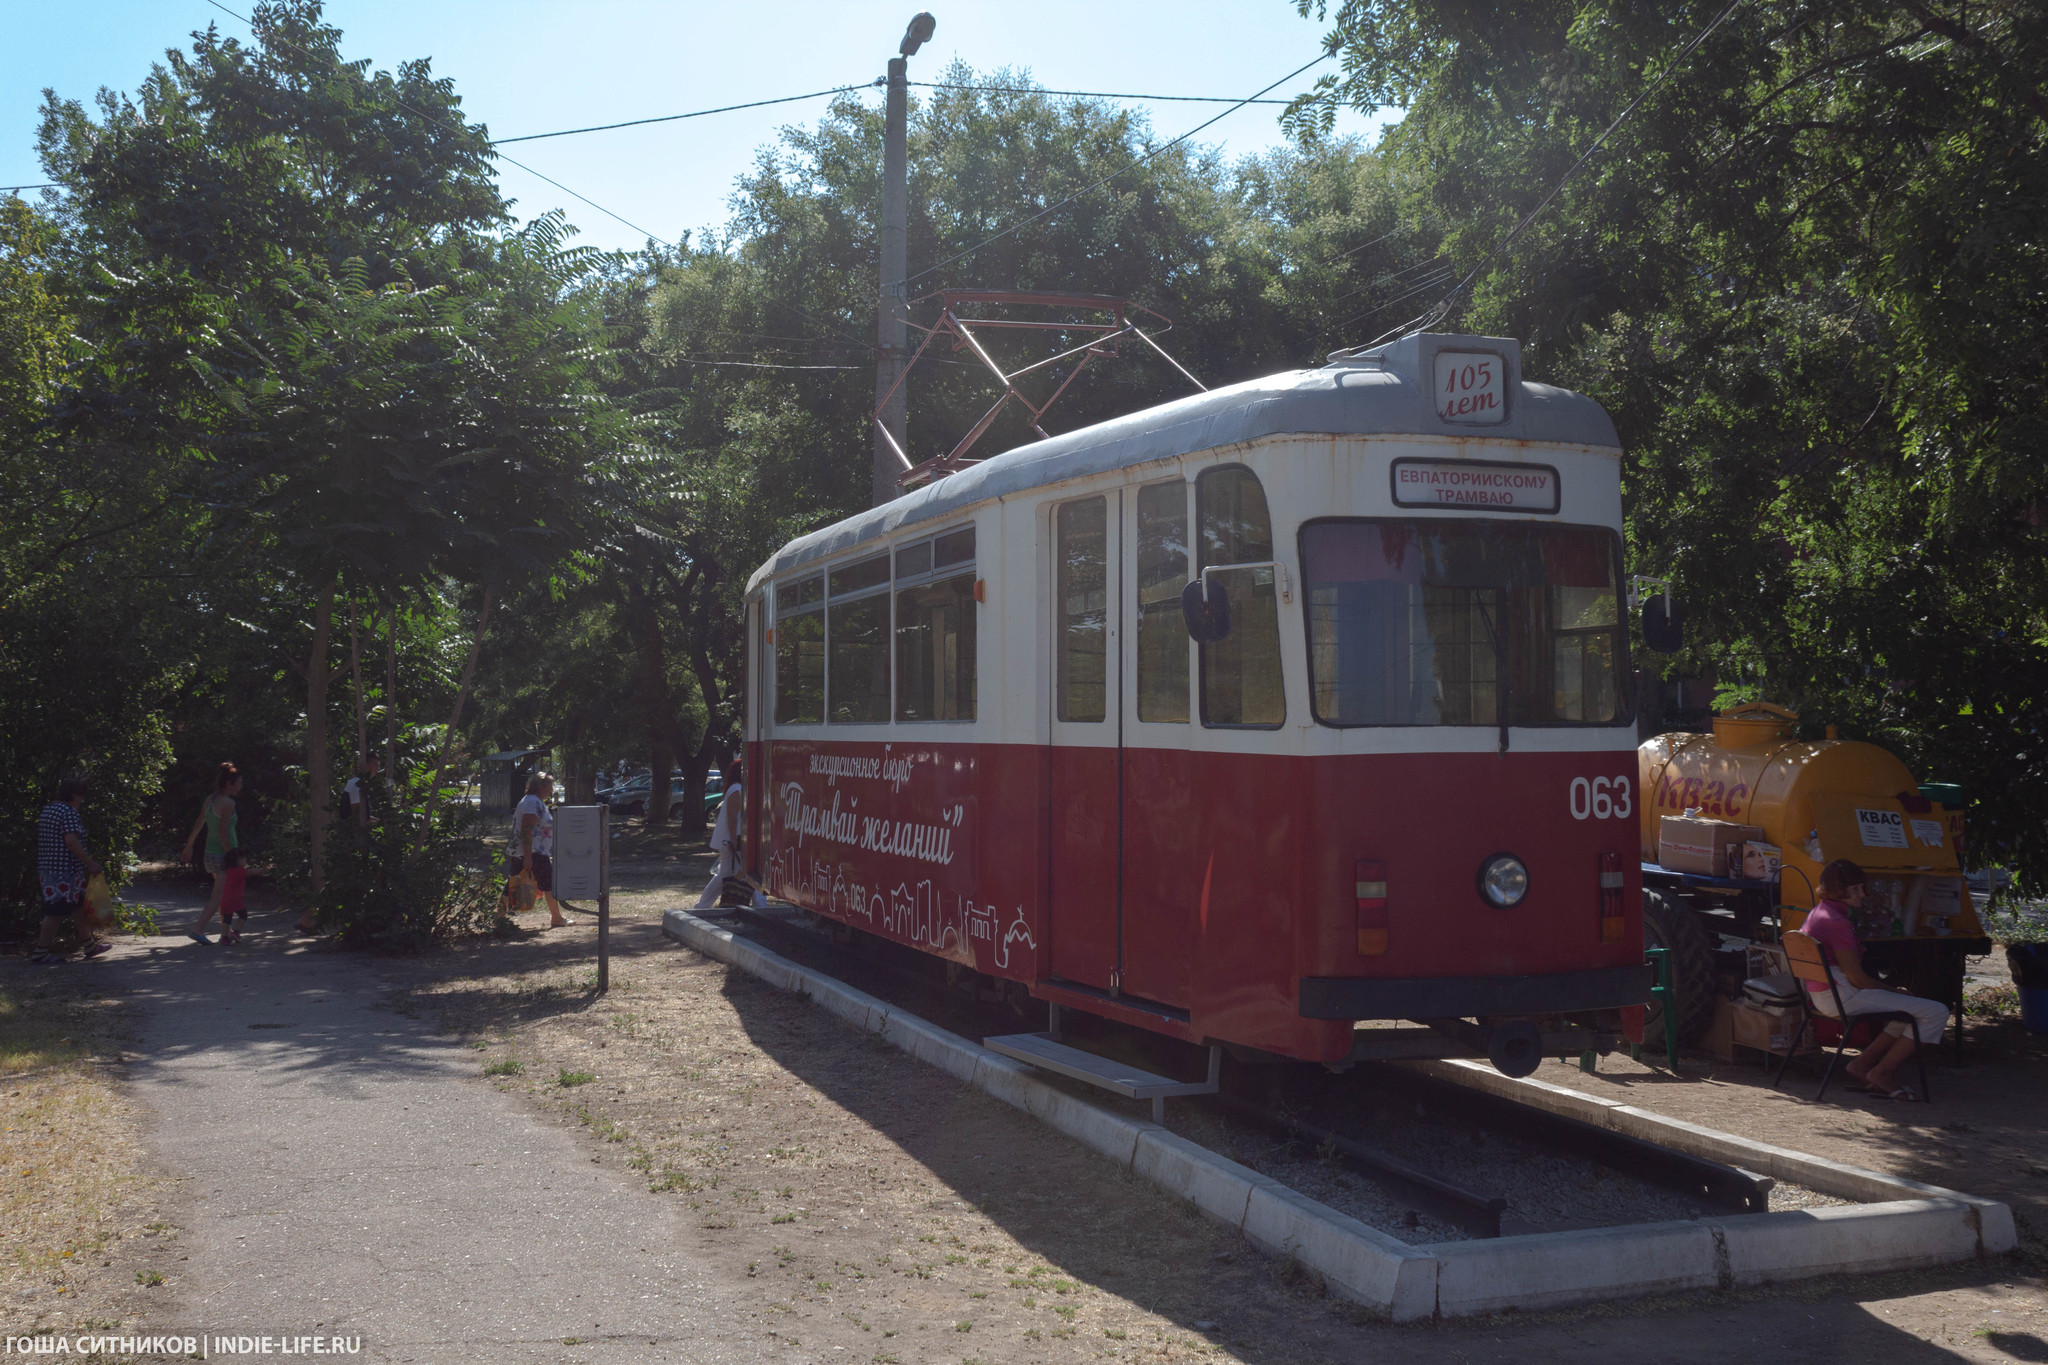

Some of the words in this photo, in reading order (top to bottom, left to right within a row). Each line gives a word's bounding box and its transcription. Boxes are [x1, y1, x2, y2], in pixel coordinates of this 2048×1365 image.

[1445, 361, 1492, 393] 105
[1440, 392, 1500, 418] лет
[1436, 489, 1514, 505] ТРАМВАЮ
[809, 753, 881, 786] экскурсионное
[882, 743, 914, 794] бюро
[1569, 775, 1632, 820] 063
[1859, 810, 1902, 826] КВАС
[850, 883, 866, 914] 063
